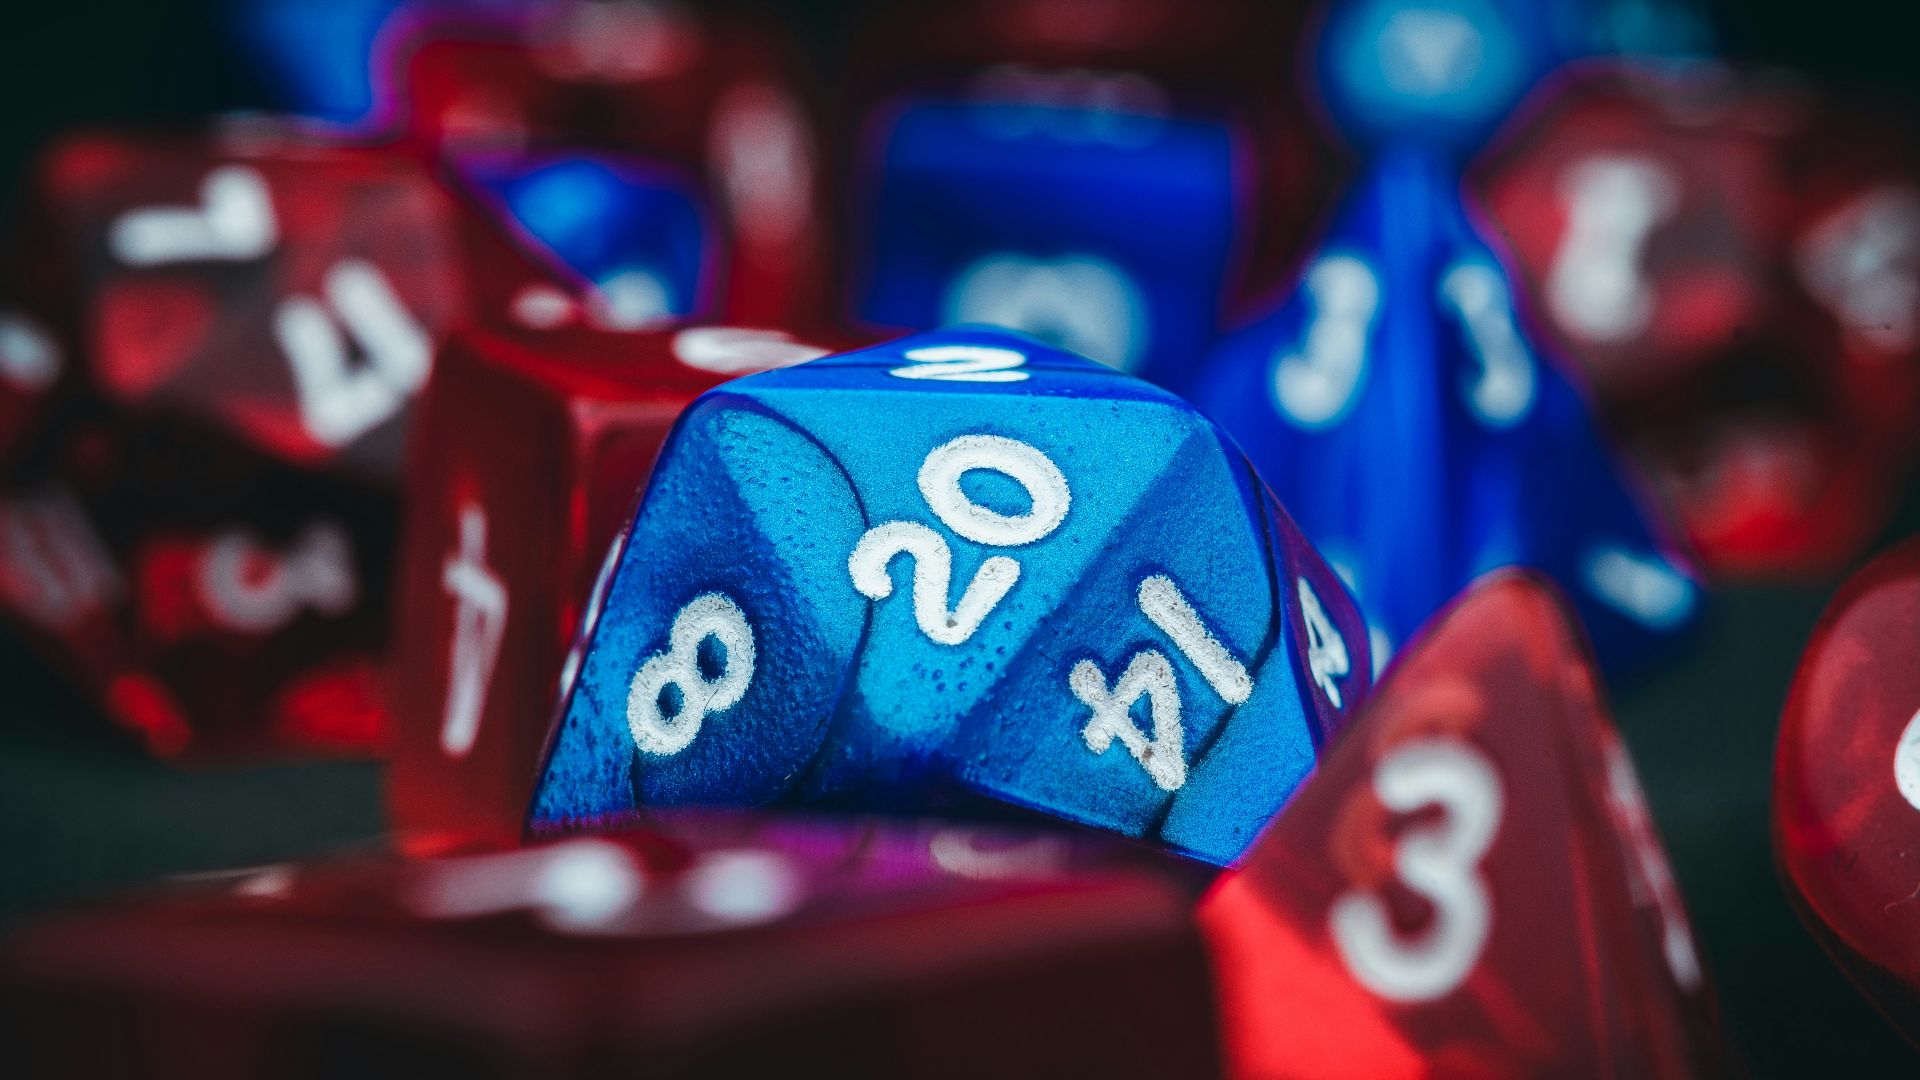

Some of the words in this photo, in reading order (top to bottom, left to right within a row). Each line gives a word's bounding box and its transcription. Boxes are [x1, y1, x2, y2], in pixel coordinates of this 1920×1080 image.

[888, 346, 1030, 383] 2
[848, 434, 1072, 646] 20
[627, 591, 756, 757] 8
[1069, 574, 1254, 791] 14
[1297, 575, 1350, 709] 4
[1330, 738, 1503, 1002] 3
